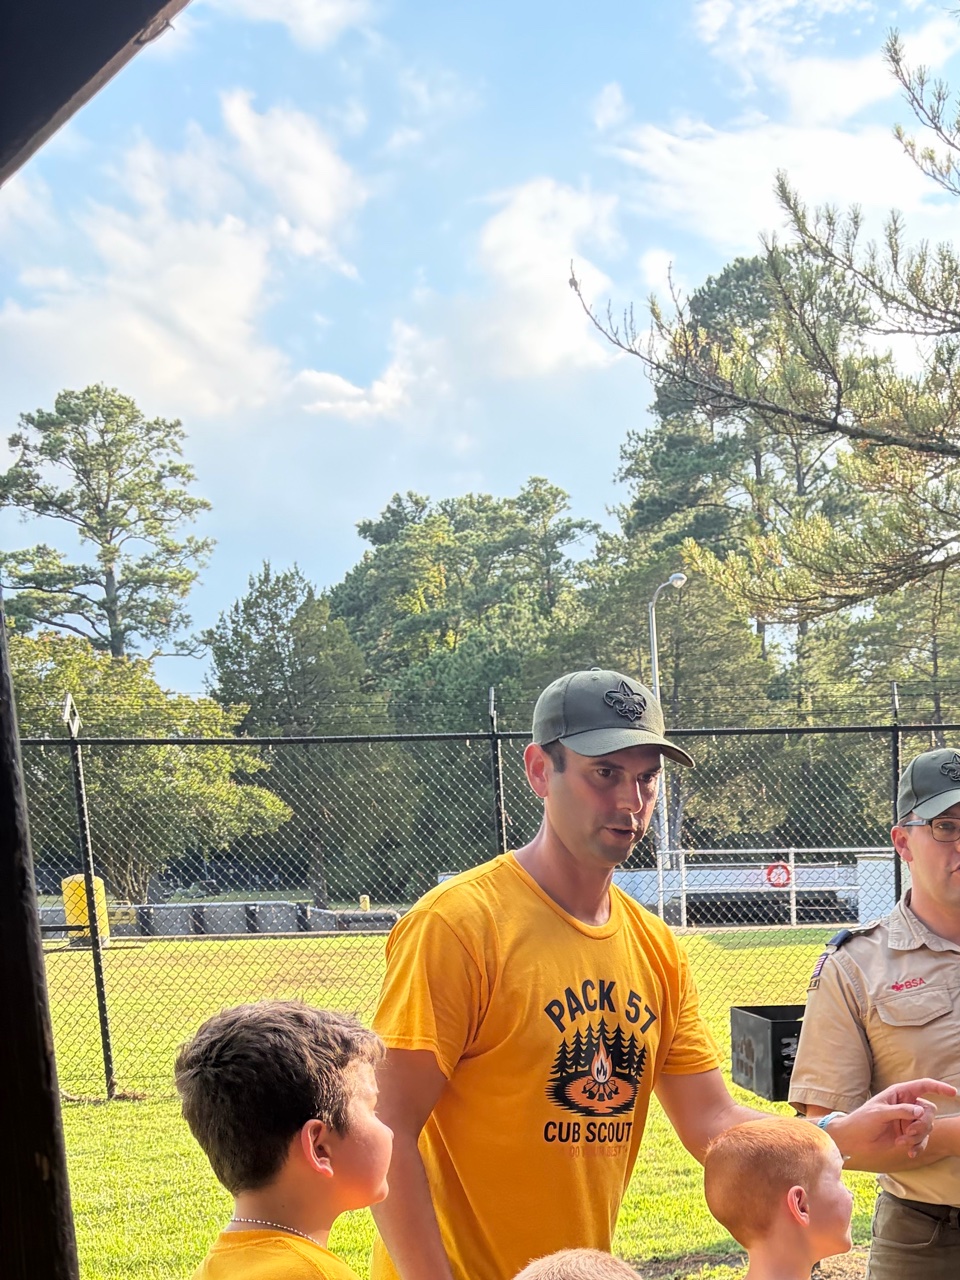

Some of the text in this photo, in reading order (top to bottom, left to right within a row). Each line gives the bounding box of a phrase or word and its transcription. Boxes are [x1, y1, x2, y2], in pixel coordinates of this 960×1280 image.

[904, 977, 927, 990] BSA
[544, 979, 657, 1034] PACK 57
[544, 1121, 581, 1143] CUB
